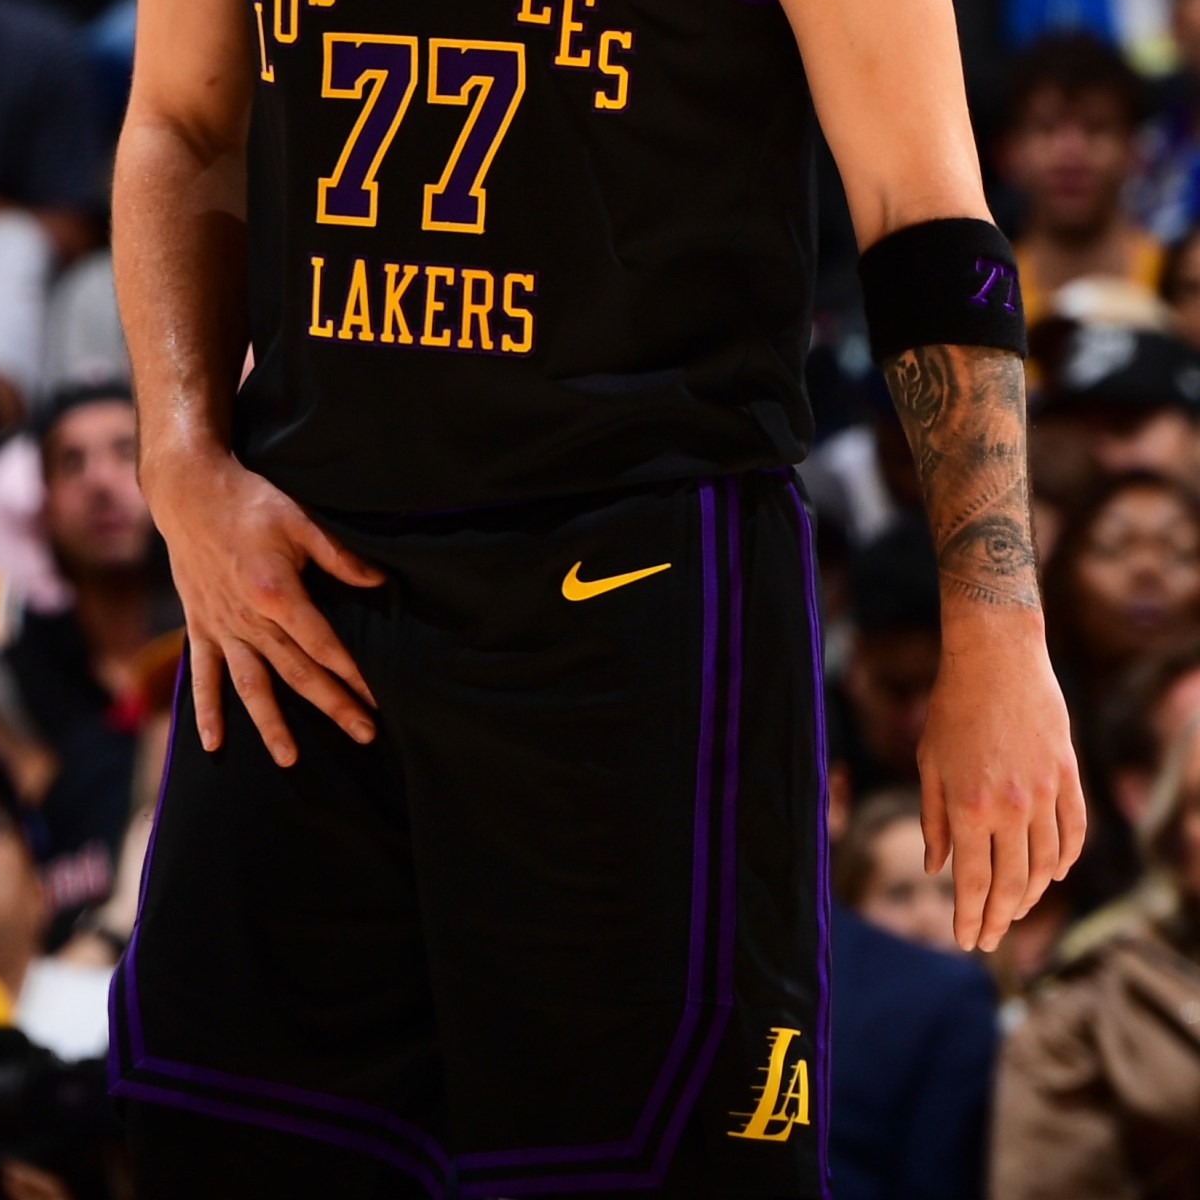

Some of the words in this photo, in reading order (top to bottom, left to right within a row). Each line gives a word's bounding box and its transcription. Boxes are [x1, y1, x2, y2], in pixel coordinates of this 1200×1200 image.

[316, 32, 526, 234] 77
[309, 256, 535, 353] LAKERS
[726, 1026, 811, 1142] LA
